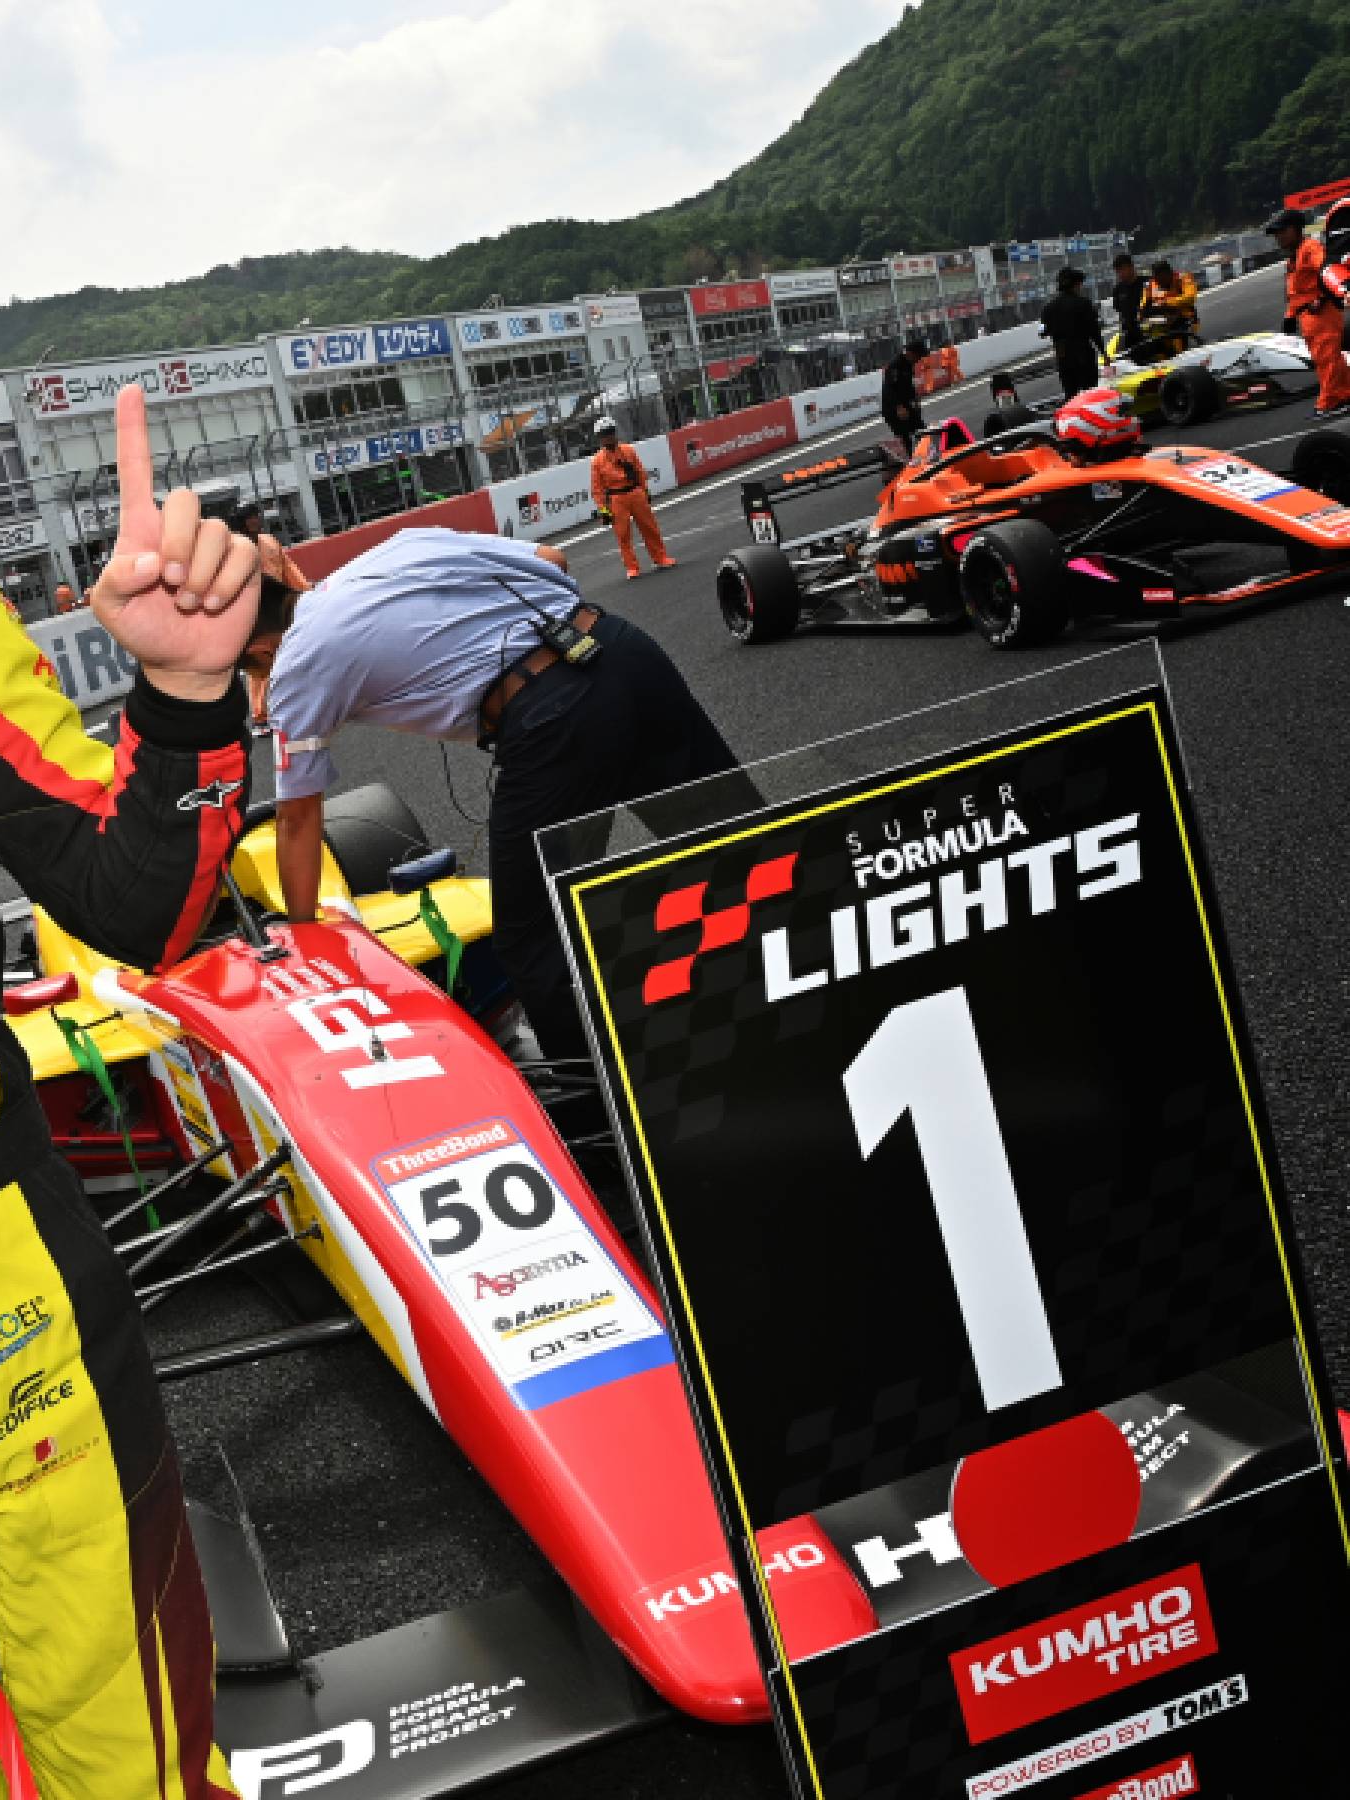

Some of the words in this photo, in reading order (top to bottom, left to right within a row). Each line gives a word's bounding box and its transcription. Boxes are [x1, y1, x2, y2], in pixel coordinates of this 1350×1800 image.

[188, 357, 268, 387] SHINKO
[291, 333, 367, 369] EXEDY
[846, 781, 1016, 854] SUPER
[852, 810, 1028, 889] FORMULA
[760, 812, 1141, 1003] LIGHTS
[382, 1123, 508, 1176] ThreeBond
[419, 1161, 555, 1257] 50
[841, 985, 1064, 1414] 1
[968, 1585, 1193, 1696] KUMHO
[1095, 1619, 1202, 1677] TIRE
[389, 1682, 475, 1718] Honda
[389, 1676, 527, 1732] FORMULA
[389, 1701, 490, 1746] DREAM
[389, 1704, 517, 1760] PROJECT
[971, 1732, 1113, 1800] POWERED
[1115, 1717, 1153, 1745] BY
[1160, 1679, 1247, 1732] TOM'S
